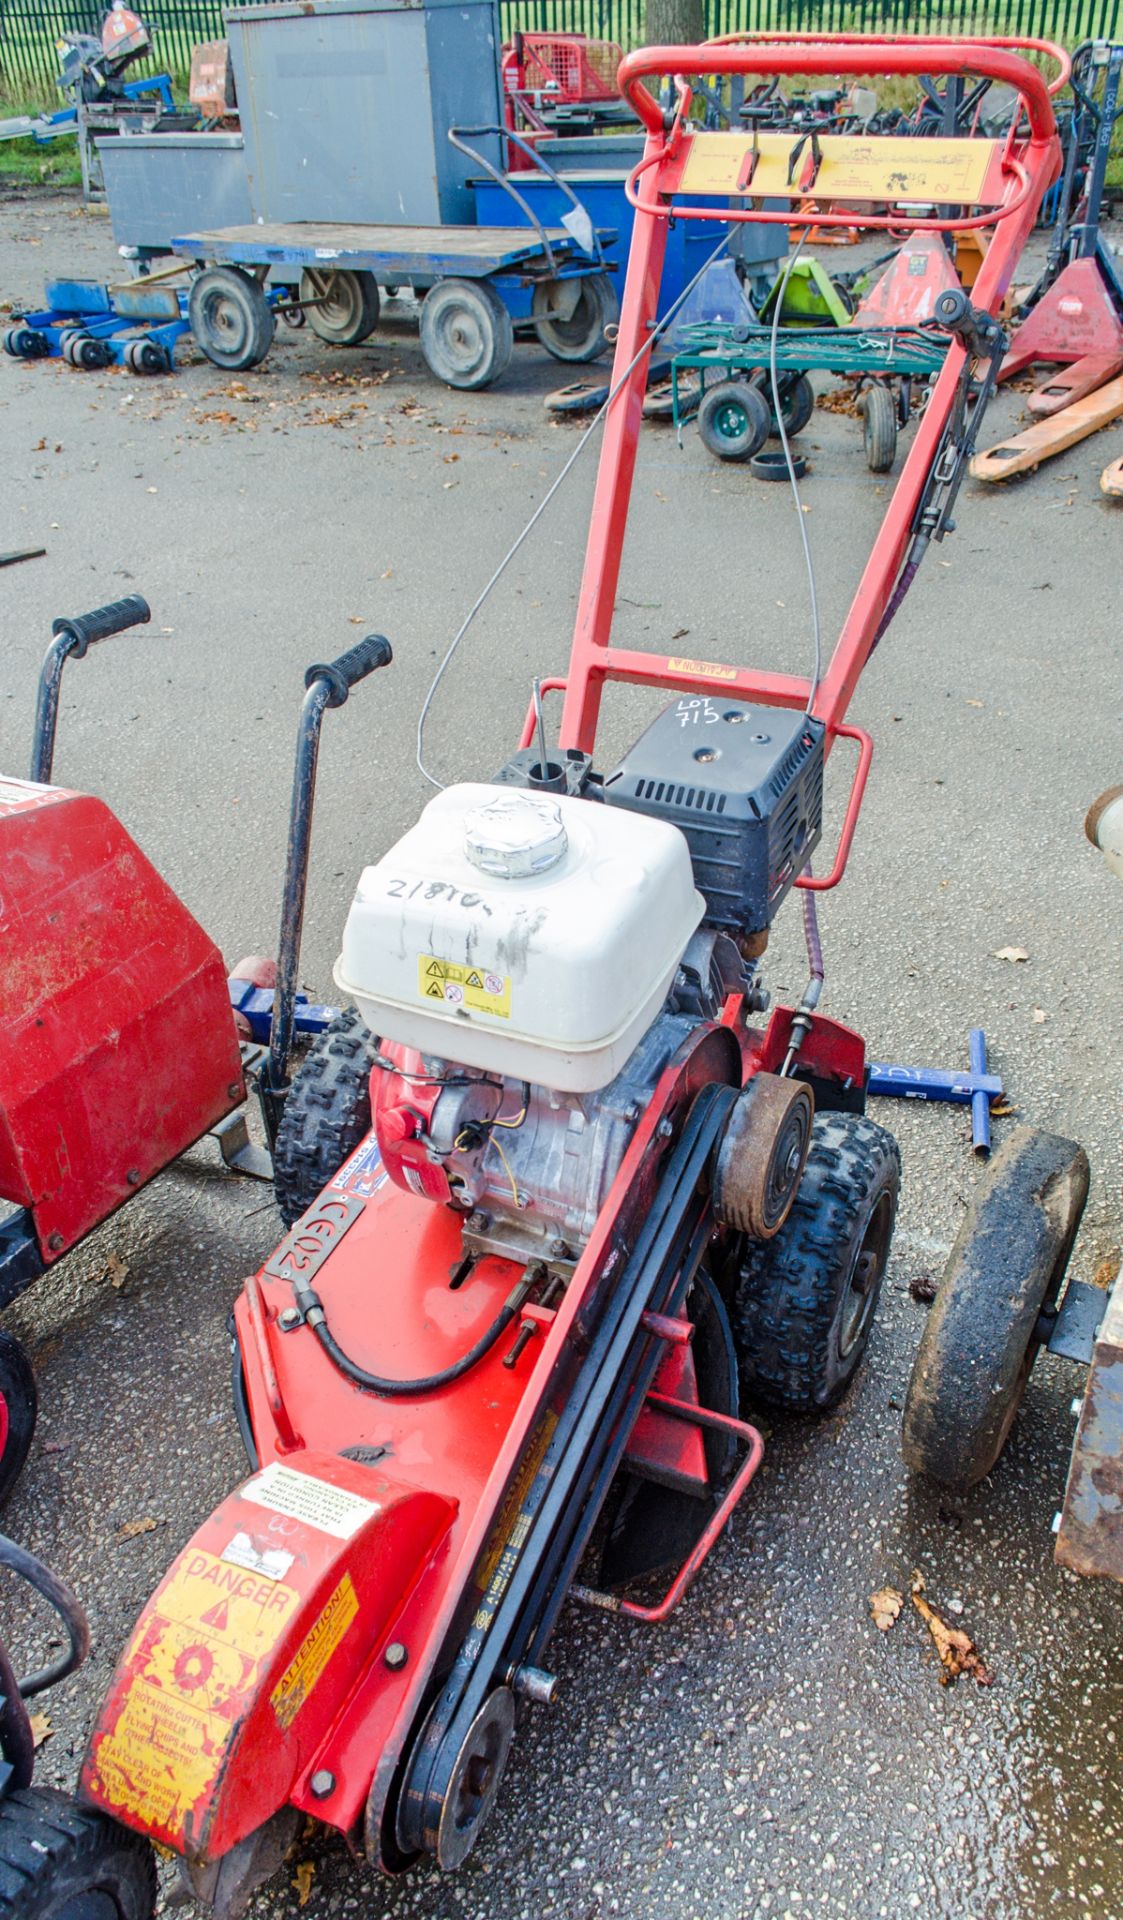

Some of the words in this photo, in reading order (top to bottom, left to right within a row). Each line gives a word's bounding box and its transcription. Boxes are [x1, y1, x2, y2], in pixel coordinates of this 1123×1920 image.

[677, 698, 712, 710] LOT
[675, 707, 720, 728] 715
[187, 1556, 290, 1614] DANGER
[281, 1587, 343, 1691] ATTENTION!
[135, 1691, 177, 1718] ROTATING
[181, 1739, 199, 1756] AND
